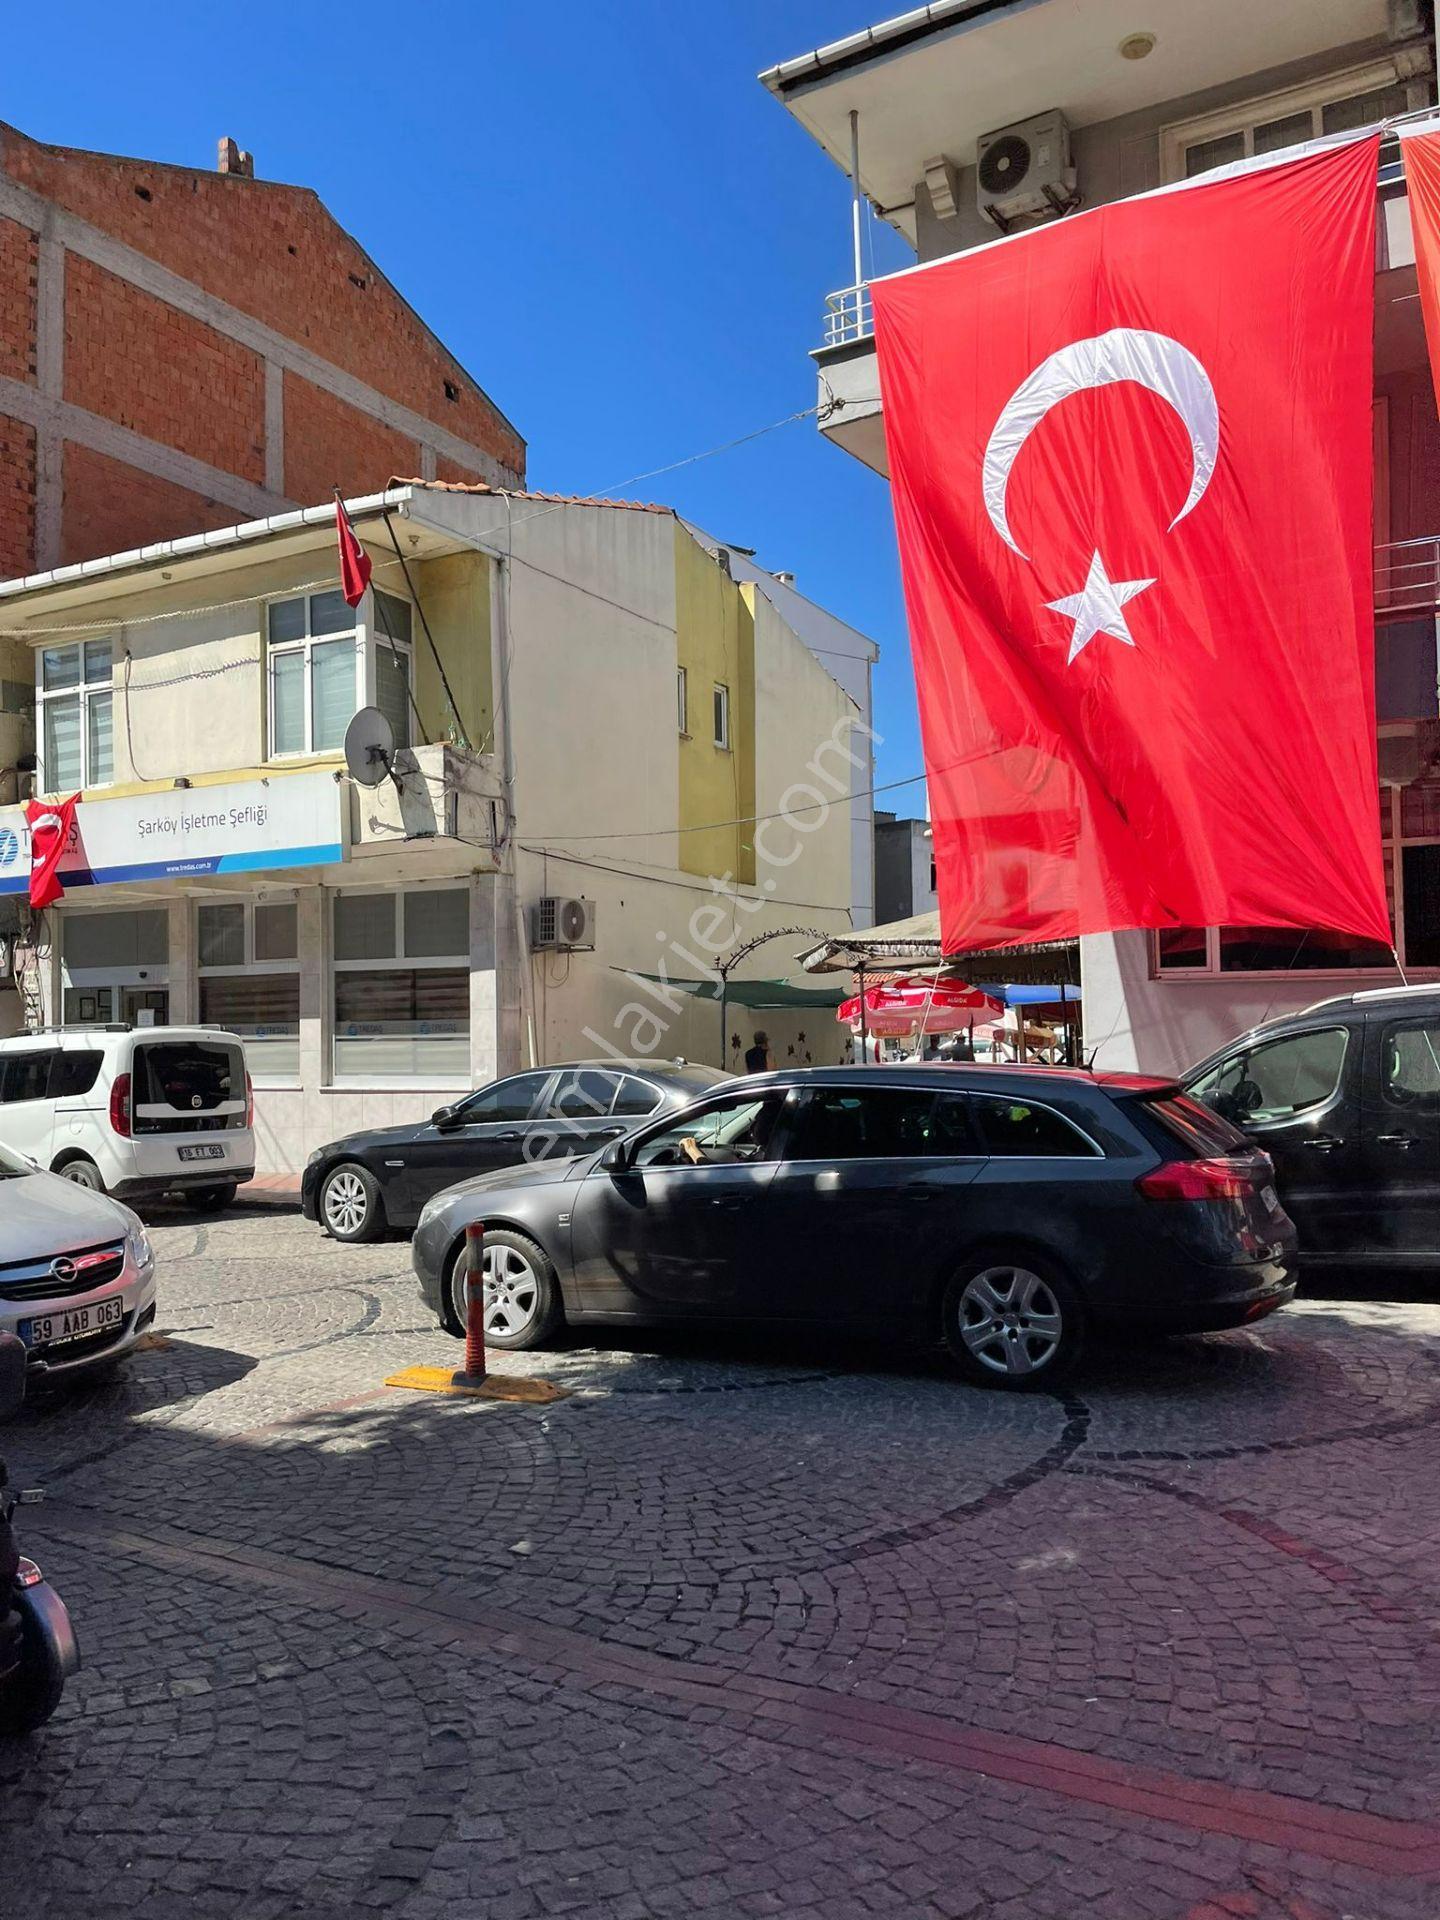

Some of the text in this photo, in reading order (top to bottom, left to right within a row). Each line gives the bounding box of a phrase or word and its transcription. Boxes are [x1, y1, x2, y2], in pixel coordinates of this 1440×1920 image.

[137, 804, 268, 838] Şarköy İşletme Şefliği
[32, 1301, 121, 1341] 59 AAB 063
